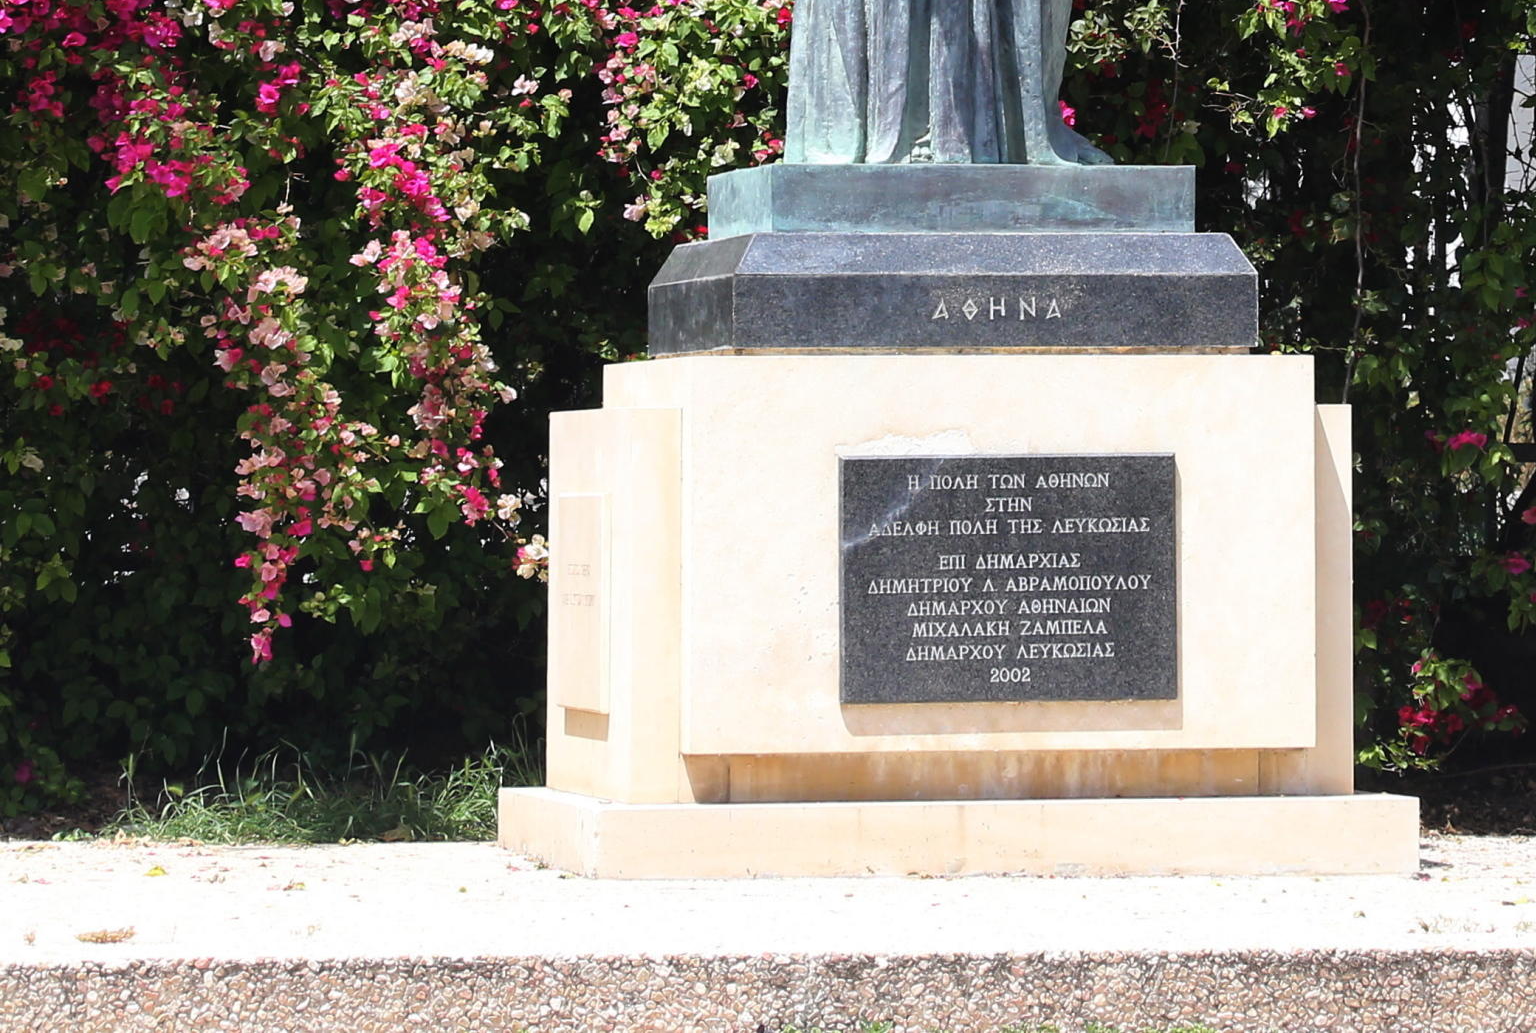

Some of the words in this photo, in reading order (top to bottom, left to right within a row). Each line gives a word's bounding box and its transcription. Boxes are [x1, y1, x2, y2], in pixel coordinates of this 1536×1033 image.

[931, 296, 1062, 321] ΑΘΗΝΑ
[907, 475, 921, 490] Η
[928, 474, 979, 490] ΠΟΛΗ
[987, 473, 1026, 490] ΤΩΝ
[1035, 472, 1111, 489] ΑΘΗΝΩΝ
[984, 496, 1033, 513] ΣΤΗΝ
[867, 520, 940, 537] ΑΔΕΛΦΗ
[949, 519, 999, 536] ΠΟΛΗ
[1007, 518, 1044, 535] ΤΗΣ
[1050, 517, 1151, 534] ΛΕΥΚΩΣΙΑΣ
[938, 554, 967, 570] ΕΠΙ
[975, 552, 1081, 570] ΔΗΜΑΡΧΙΑΣ
[867, 577, 973, 595] ΔΗΜΗΤΡΙΟΥ
[1005, 573, 1152, 593] ΑΒΡΑΜΟΠΟΥΛΟΥ
[907, 599, 1010, 617] ΔΗΜΑΡΧΟΥ
[1017, 597, 1112, 615] ΑΘΗΝΑΙΩΝ
[912, 620, 1010, 638] ΜΙΧΑΛΑΚΗ
[1019, 619, 1108, 636] ΖΑΜΠΕΛΑ
[905, 643, 1007, 662] ΔΗΜΑΡΧΟΥ
[1016, 641, 1115, 659] ΛΕΥΚΩΣΙΑΣ
[989, 667, 1032, 683] 2002
